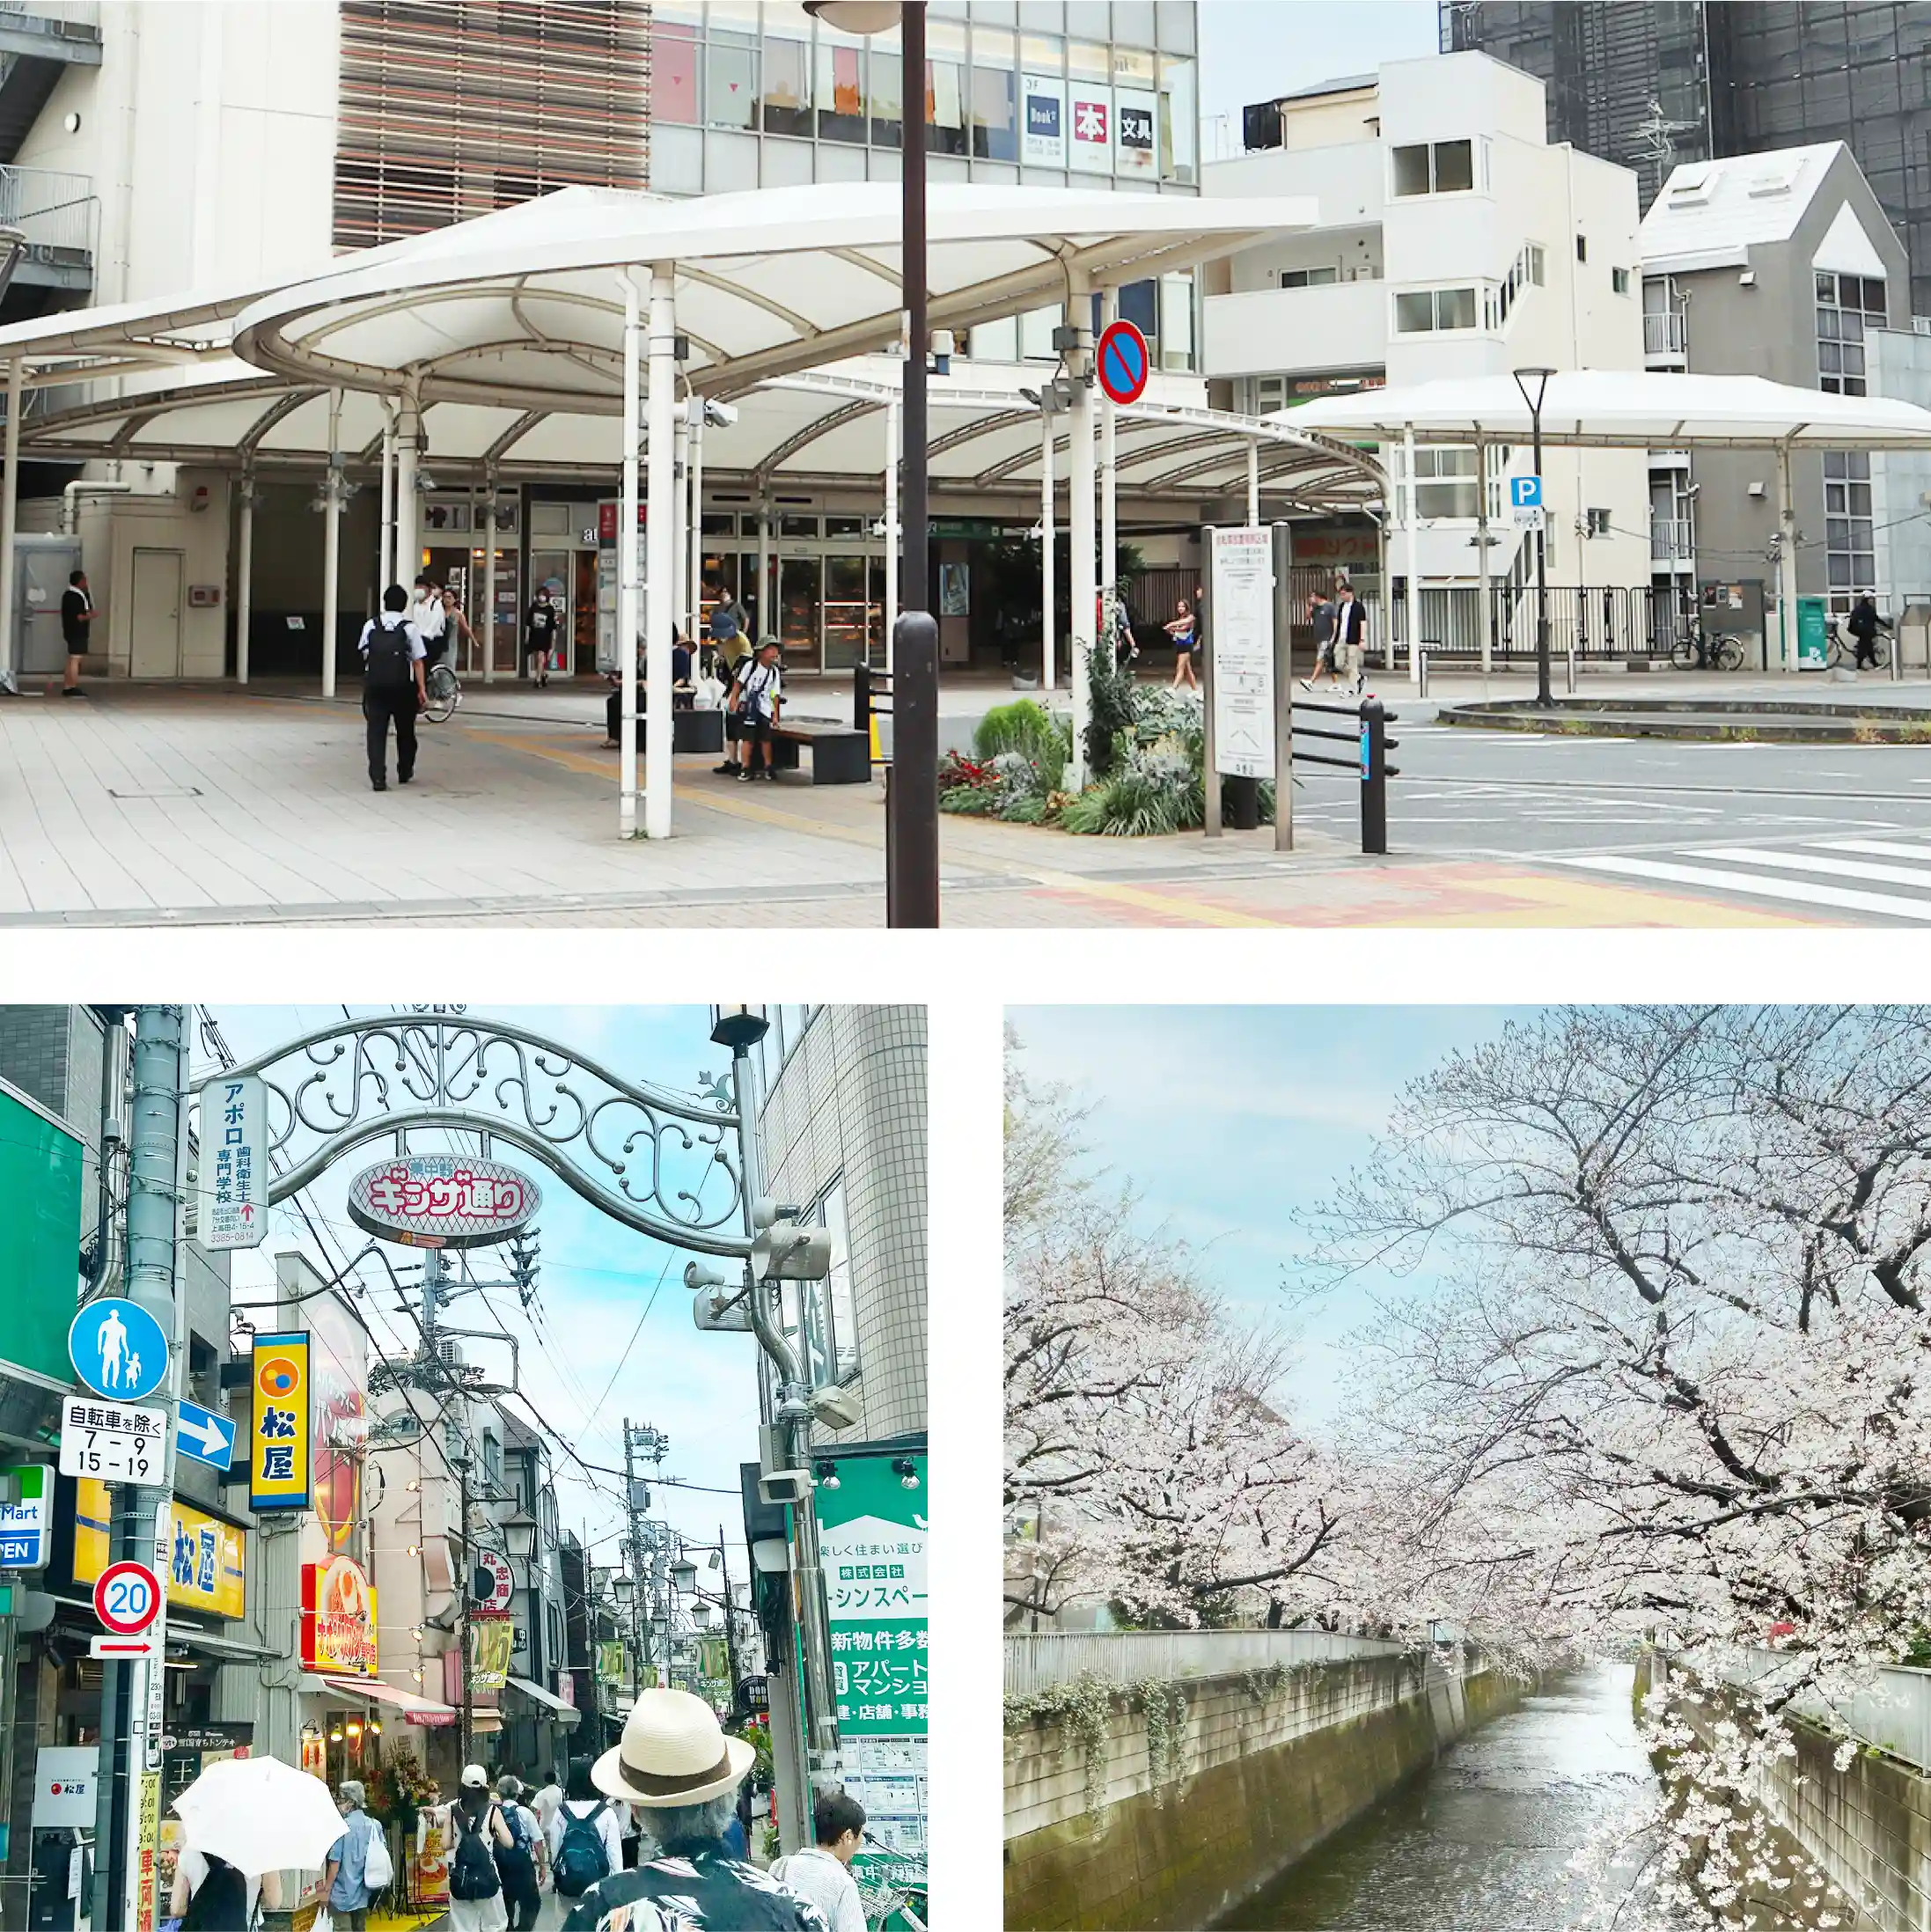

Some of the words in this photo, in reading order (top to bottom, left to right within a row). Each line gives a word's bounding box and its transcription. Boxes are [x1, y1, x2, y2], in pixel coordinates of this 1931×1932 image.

[1077, 105, 1105, 140] 本
[1122, 117, 1151, 140] 文具
[1518, 480, 1536, 504] P
[224, 1084, 244, 1145] アポロ
[216, 1150, 231, 1203] 専門学校
[236, 1146, 252, 1202] 歯科衛生士
[409, 1161, 453, 1178] 東中野
[371, 1167, 524, 1217] ギンザ通り
[211, 1231, 253, 1243] 3385-0814
[70, 1406, 161, 1435] 自転車を除く
[260, 1406, 296, 1480] 松屋
[0, 1505, 39, 1520] Mart
[172, 1520, 217, 1594] 松屋
[819, 1543, 923, 1557] 楽しく住まい選び
[483, 1553, 510, 1610] 丸忠商店
[840, 1565, 904, 1580] 株式会社
[109, 1583, 147, 1613] 20
[852, 1659, 929, 1679] アパート
[64, 1783, 85, 1795] 松屋
